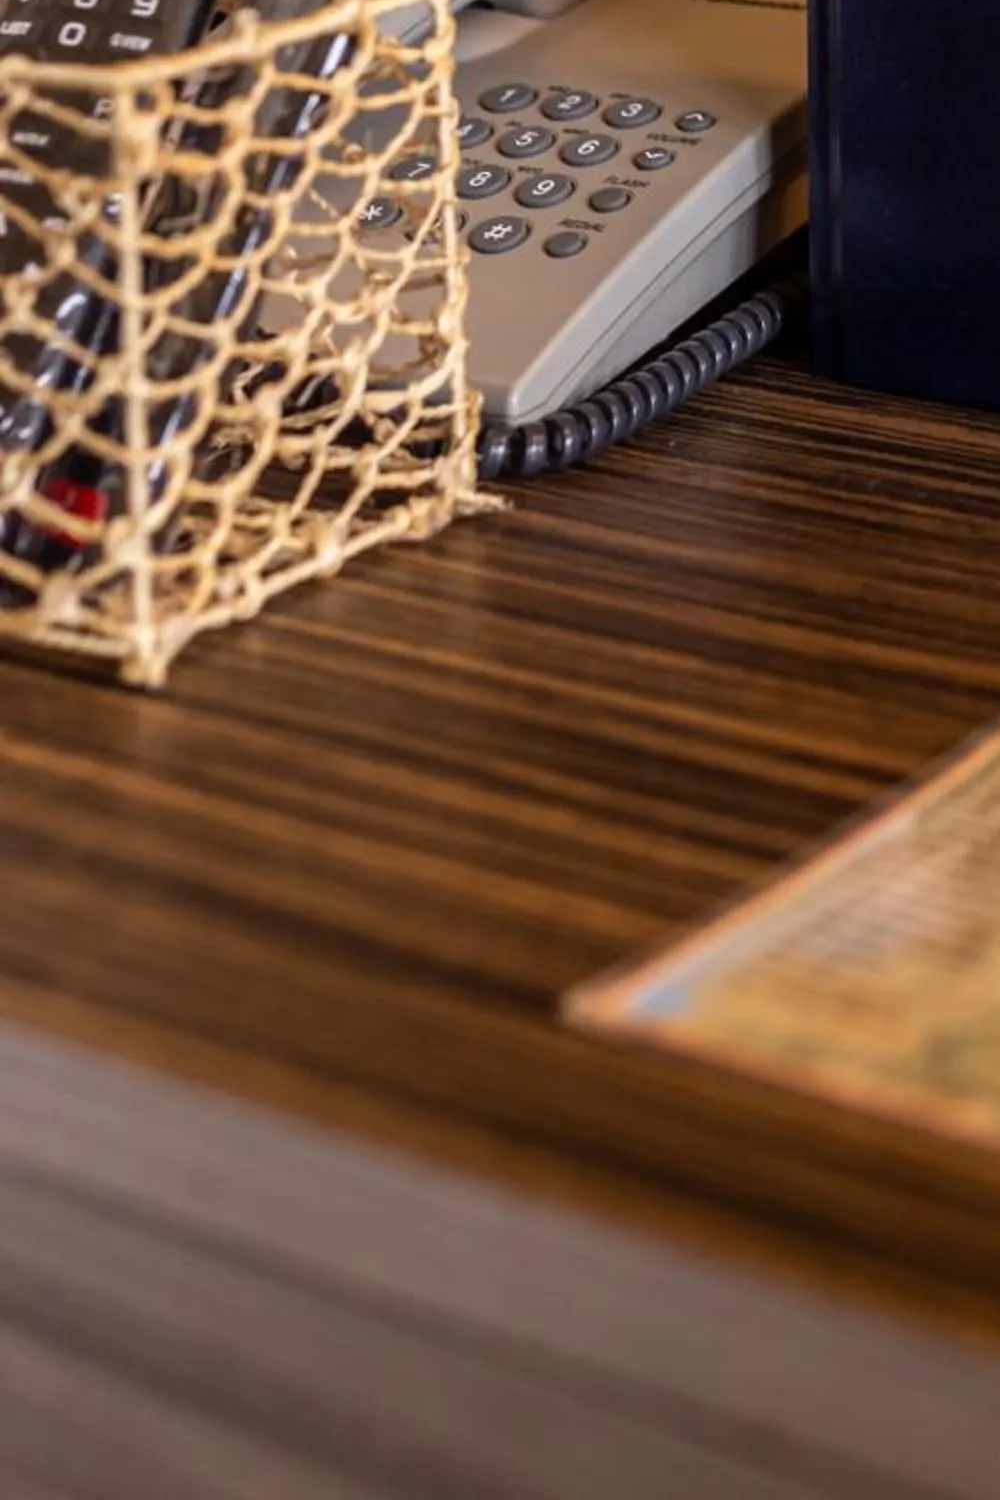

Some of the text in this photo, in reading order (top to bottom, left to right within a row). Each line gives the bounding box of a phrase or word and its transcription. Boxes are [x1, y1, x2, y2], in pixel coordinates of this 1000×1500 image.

[58, 22, 86, 46] 0
[500, 88, 644, 117] 1 2 3
[514, 131, 540, 147] 5
[577, 139, 601, 155] 6
[408, 162, 555, 195] 7 8 9
